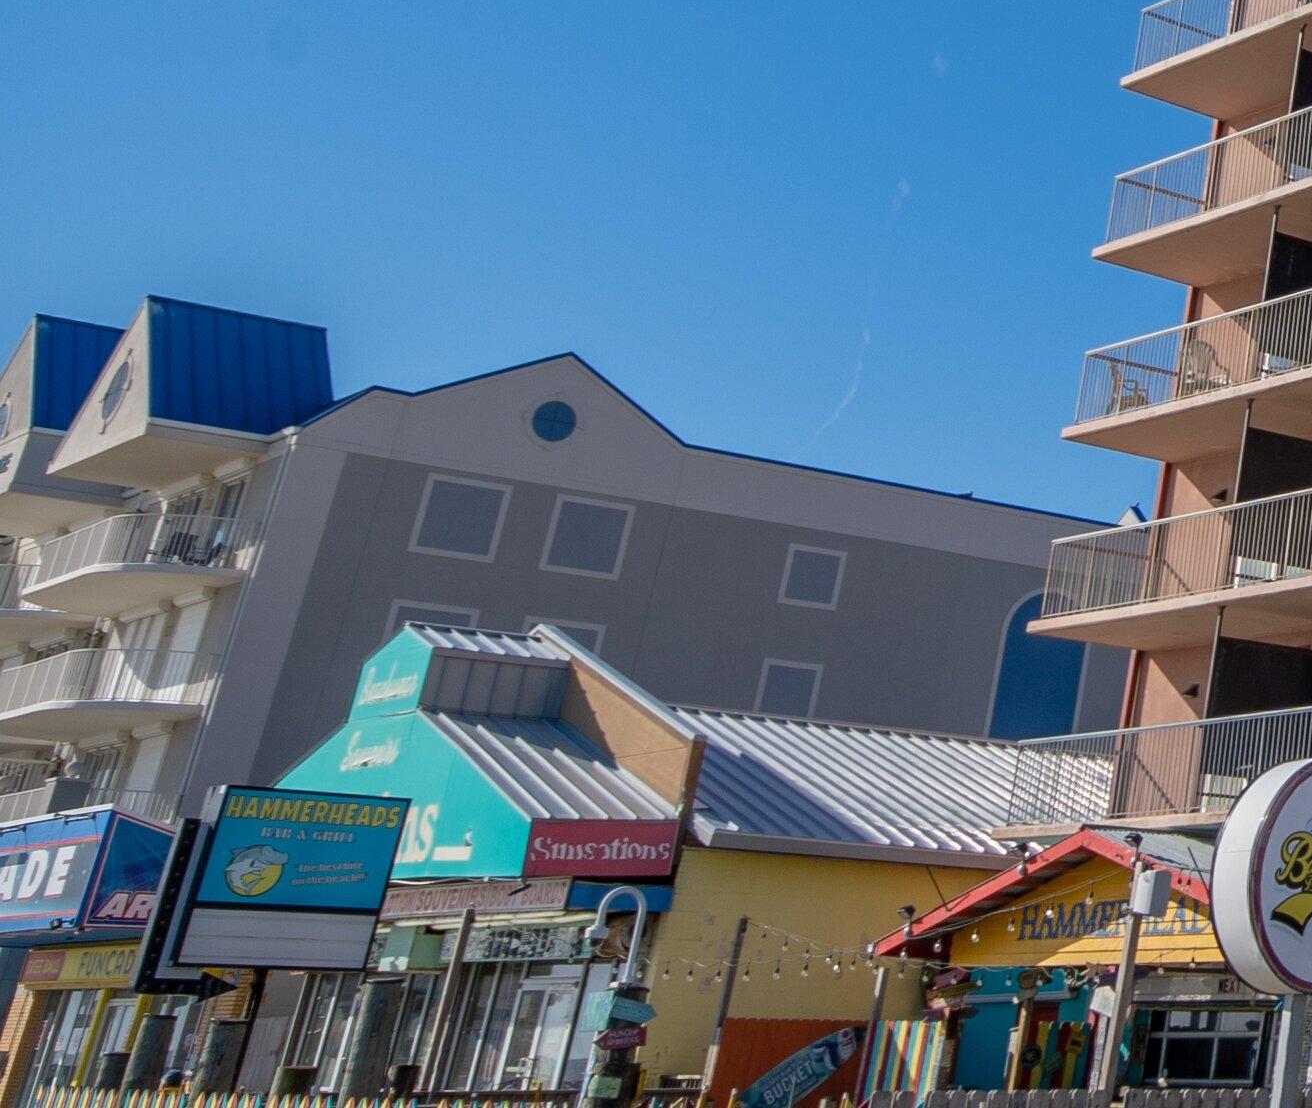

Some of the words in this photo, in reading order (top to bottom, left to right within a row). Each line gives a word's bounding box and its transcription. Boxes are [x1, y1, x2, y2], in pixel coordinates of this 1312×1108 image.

[225, 795, 401, 829] HAMMERHEADS
[530, 837, 671, 861] Sunsations
[78, 949, 137, 976] FUNCAD
[763, 1060, 814, 1105] BUCKET
